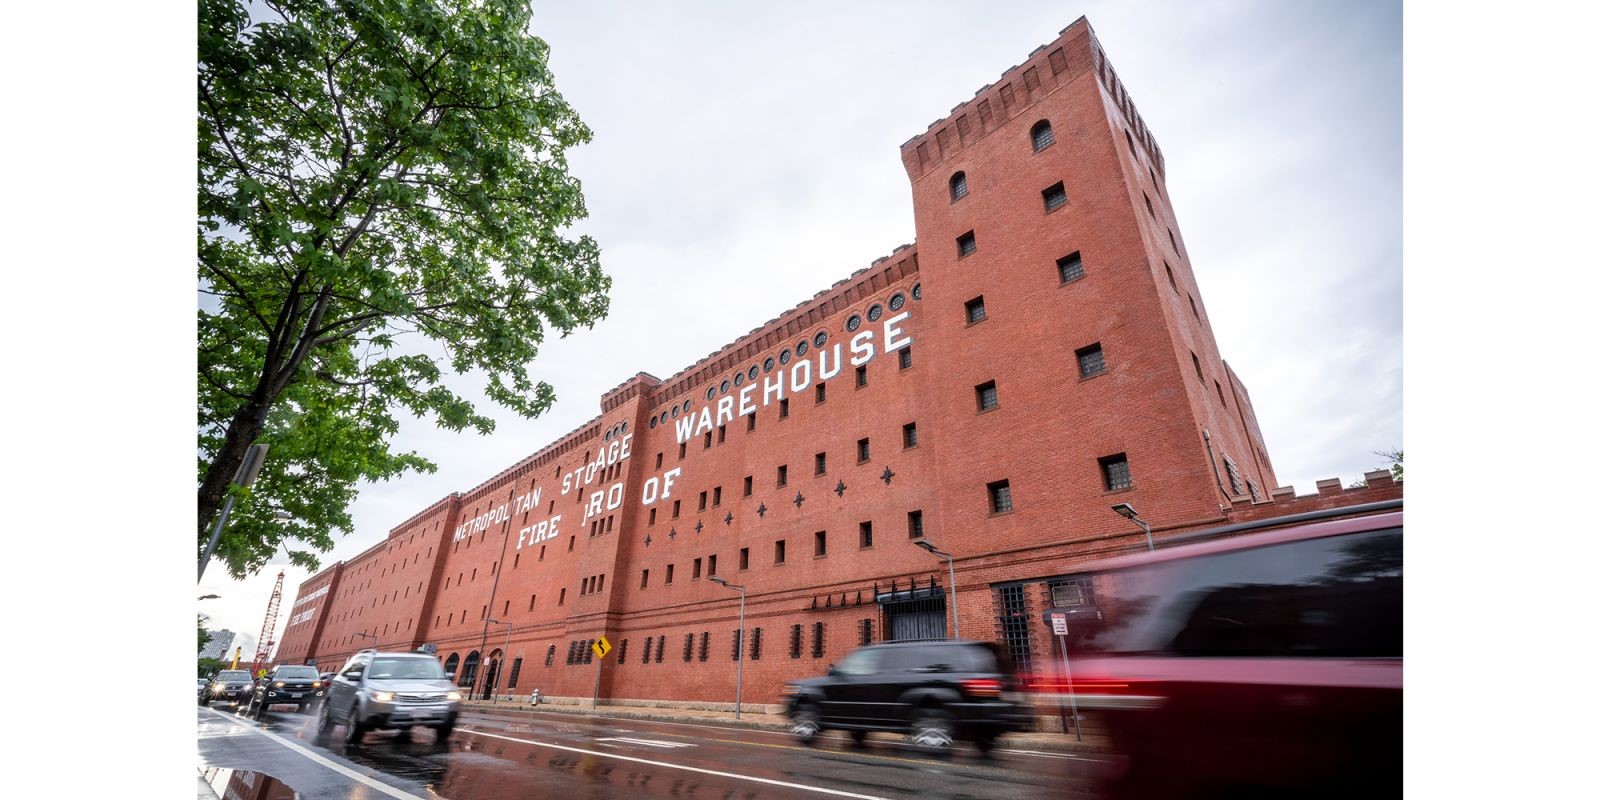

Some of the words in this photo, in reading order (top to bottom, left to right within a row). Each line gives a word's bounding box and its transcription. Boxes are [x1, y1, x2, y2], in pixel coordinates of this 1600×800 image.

[561, 433, 633, 495] STOAGE
[675, 311, 913, 444] WAREHOUSE
[516, 515, 561, 549] FIRE
